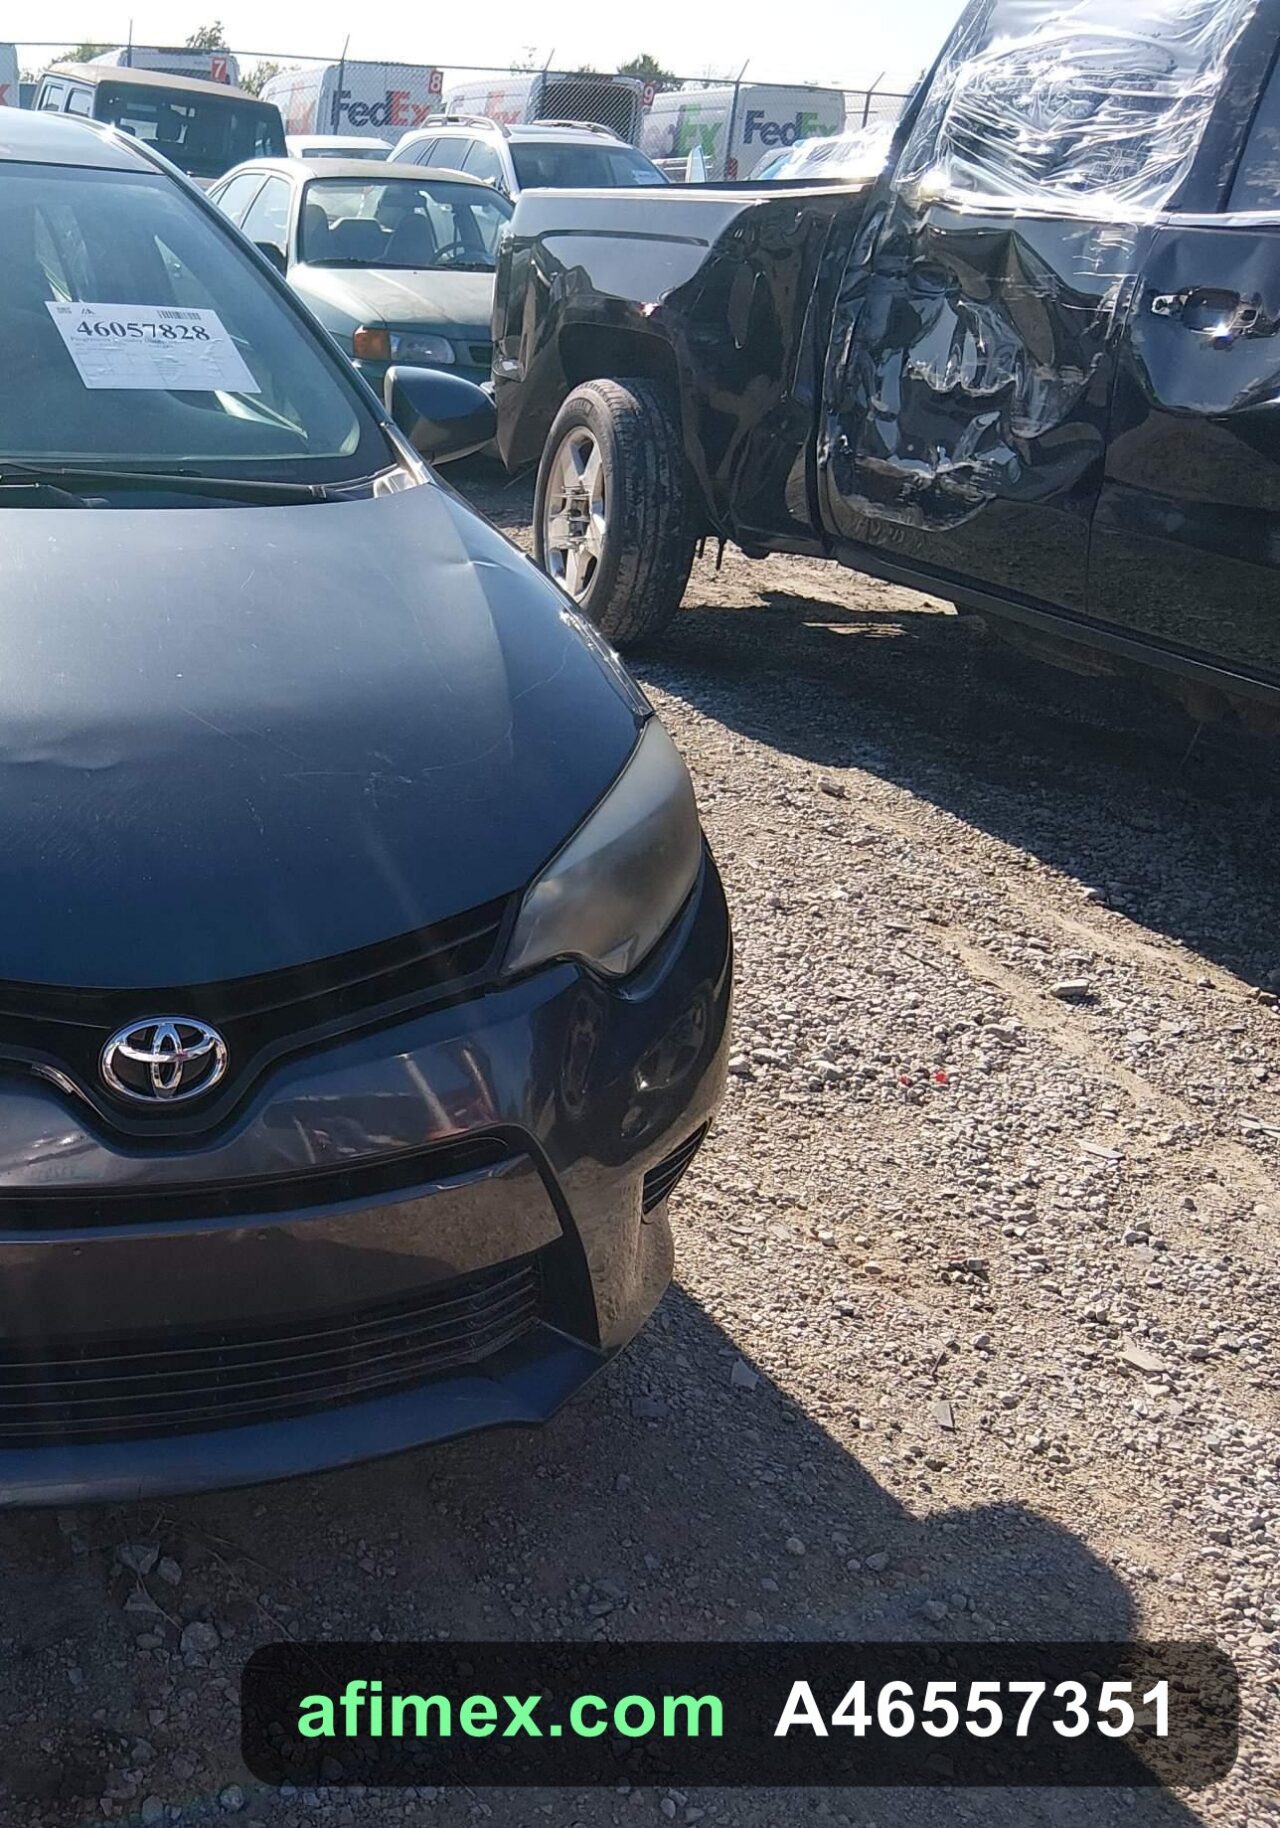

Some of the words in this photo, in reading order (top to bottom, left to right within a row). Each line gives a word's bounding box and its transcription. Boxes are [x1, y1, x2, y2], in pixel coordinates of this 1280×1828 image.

[213, 60, 225, 78] 7
[430, 72, 442, 91] 8
[644, 86, 655, 104] 9
[331, 90, 430, 127] FedEx
[77, 320, 210, 341] 46057828
